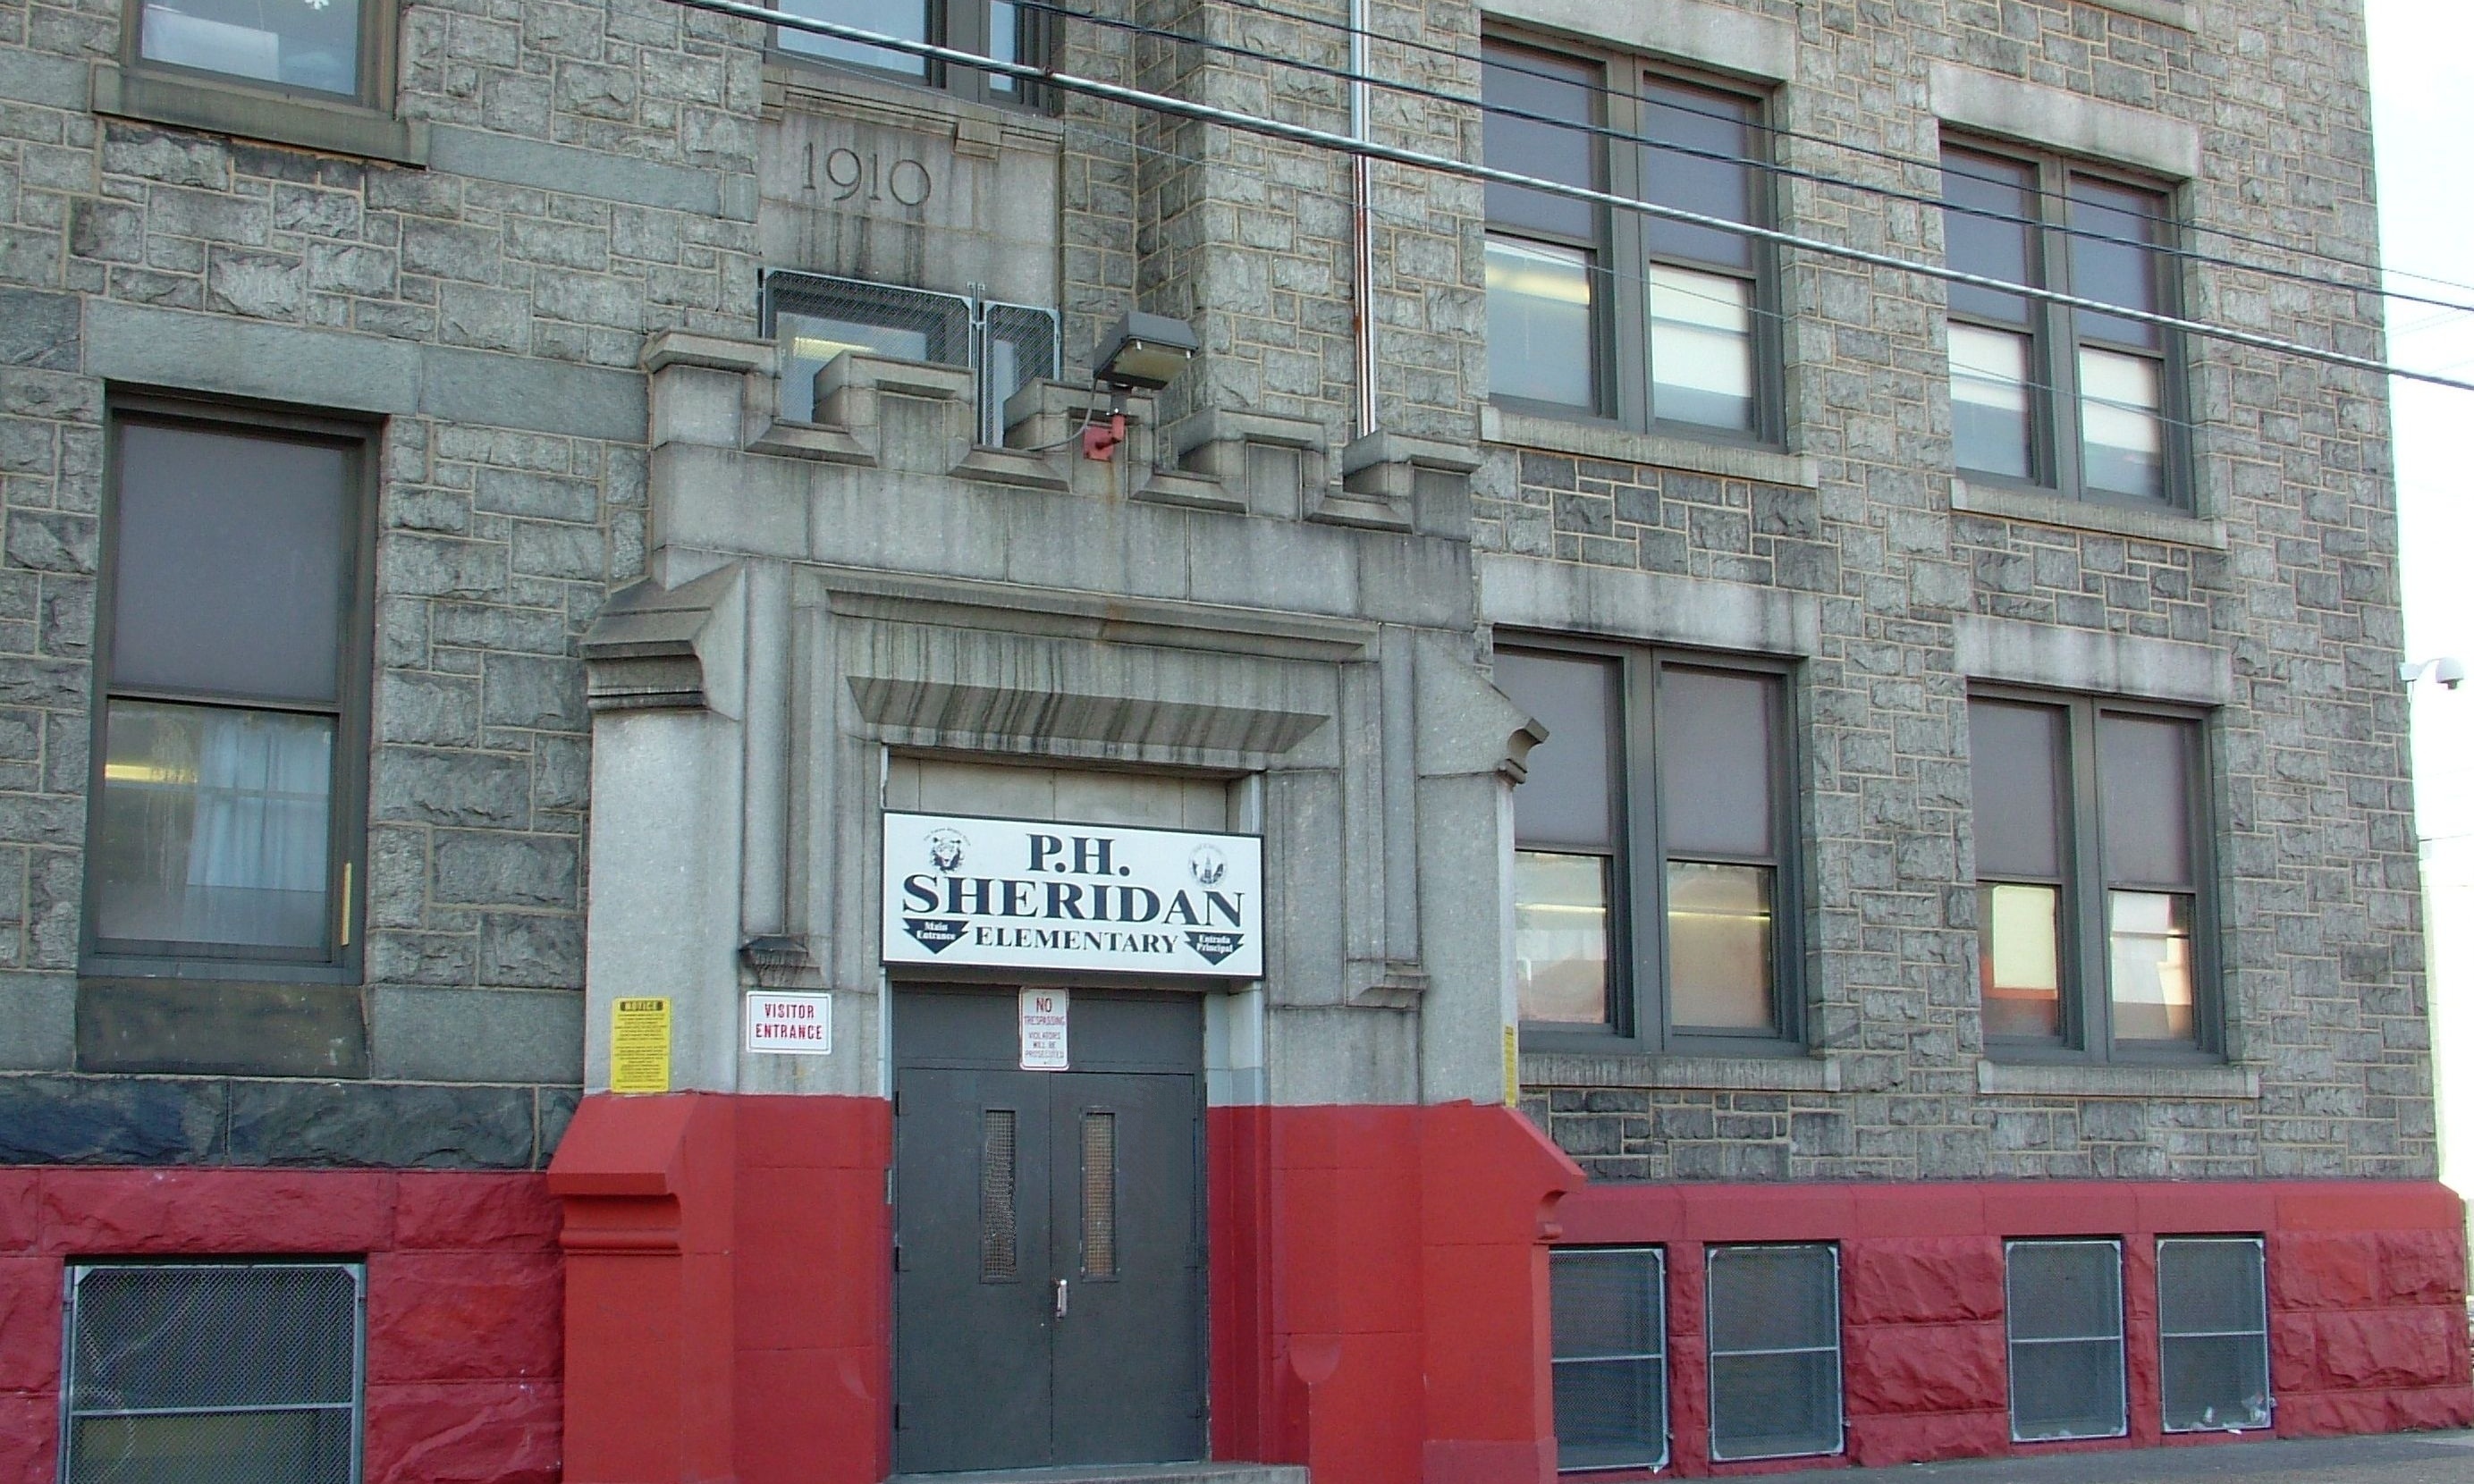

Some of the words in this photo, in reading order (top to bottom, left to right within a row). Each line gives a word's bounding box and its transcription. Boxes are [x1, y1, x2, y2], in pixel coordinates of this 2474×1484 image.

[803, 141, 932, 207] 1910
[1026, 832, 1131, 878] P.H.
[902, 873, 1245, 928] SHERIDAN
[925, 921, 949, 932] Main
[916, 930, 956, 940] Entrance
[975, 926, 1178, 954] ELEMENTARY
[1196, 943, 1233, 954] Principal
[764, 1002, 815, 1019] VISITOR
[1036, 997, 1052, 1013] NO
[756, 1024, 823, 1040] ENTRANCE
